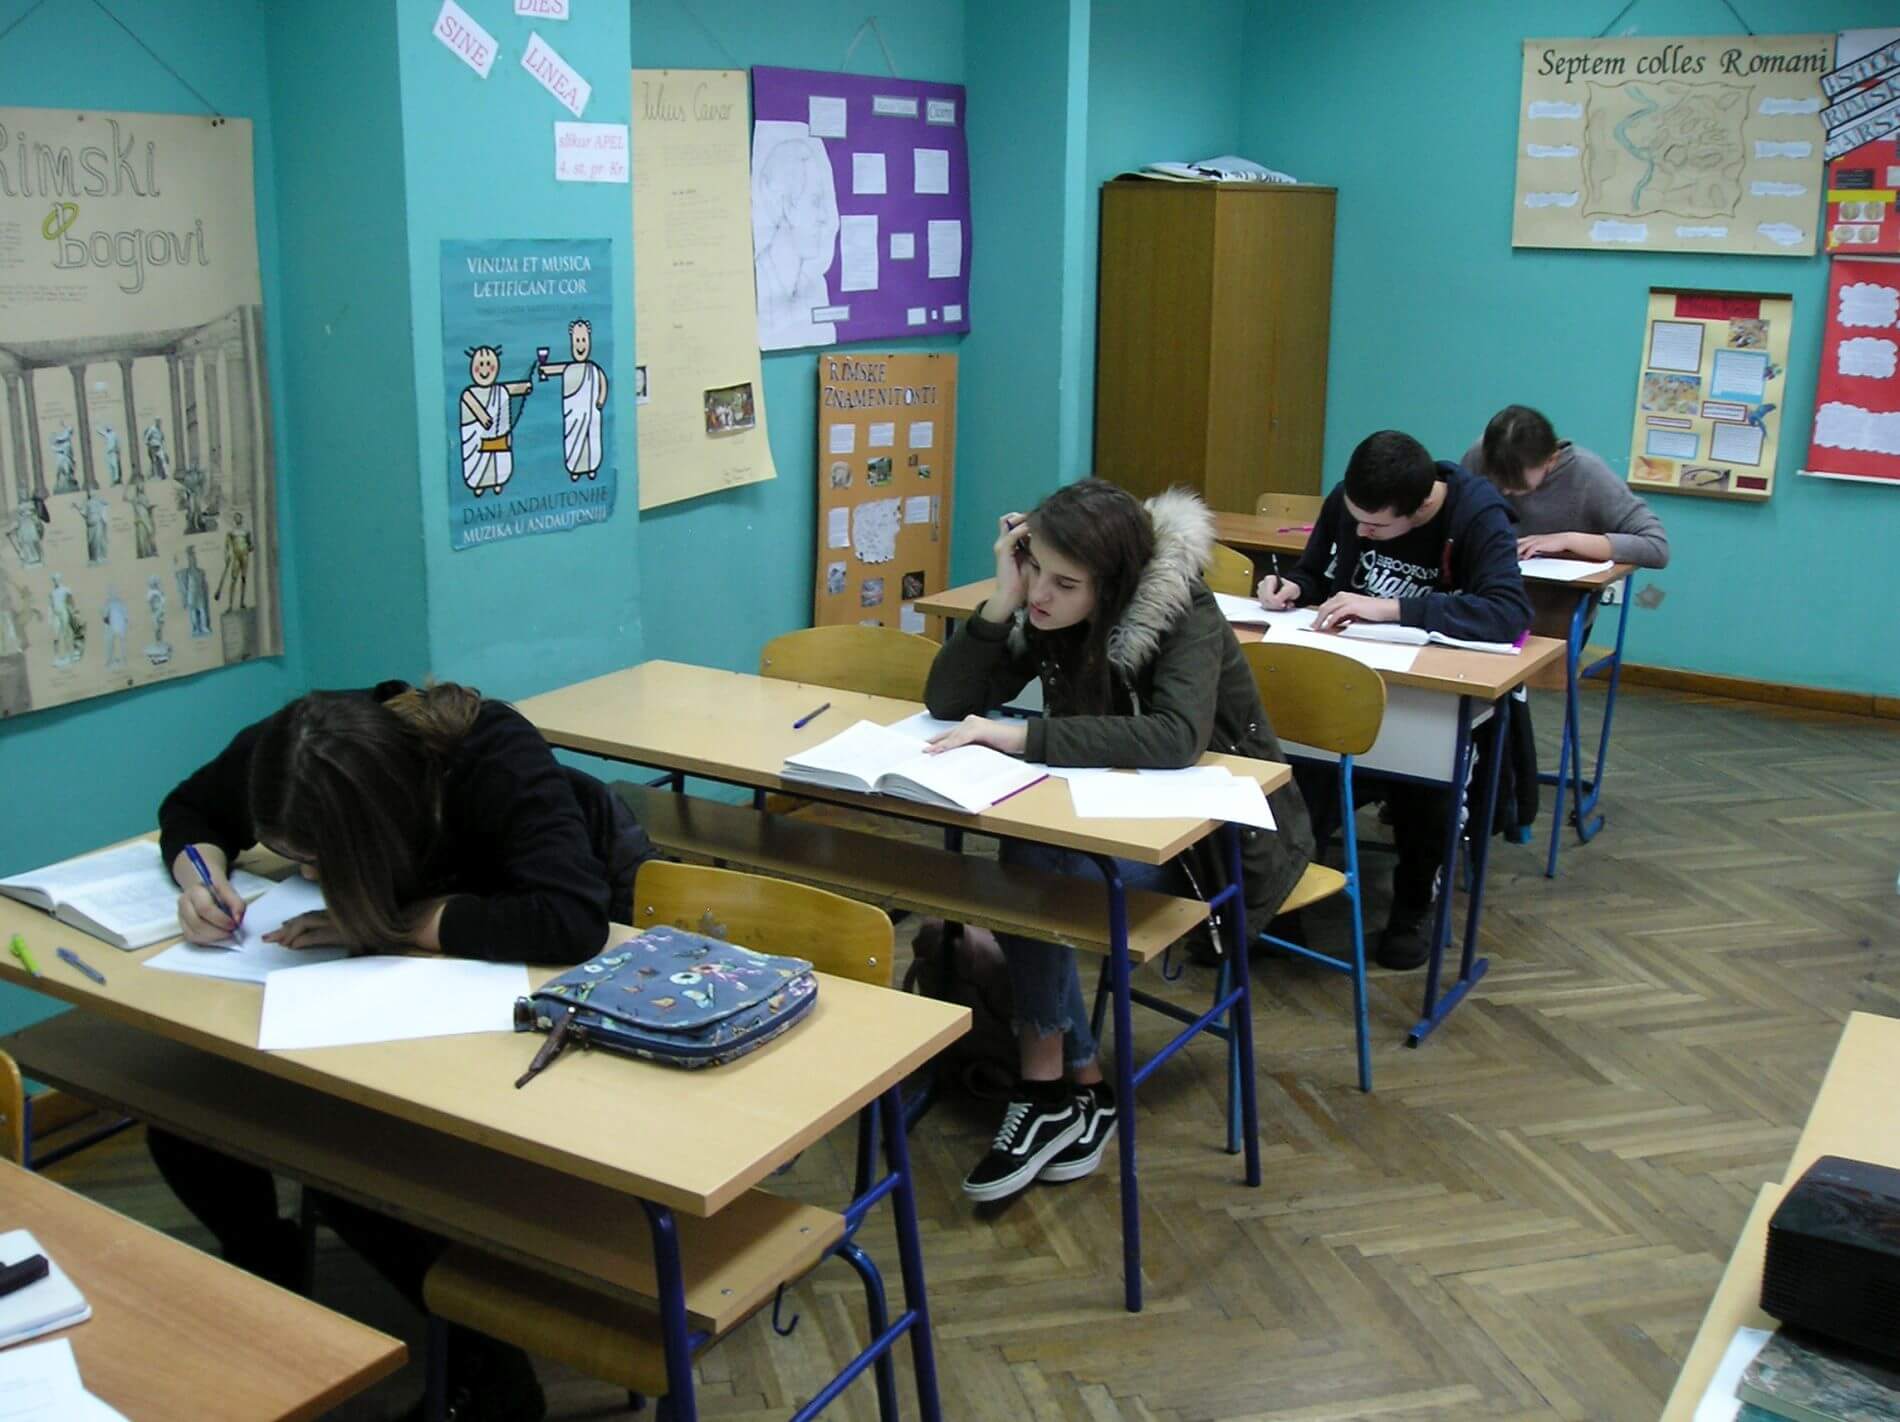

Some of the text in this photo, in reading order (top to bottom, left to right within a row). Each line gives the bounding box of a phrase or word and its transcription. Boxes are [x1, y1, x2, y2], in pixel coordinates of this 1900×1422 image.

[439, 15, 489, 67] SINE
[1538, 45, 1828, 84] Septem colles Romani
[467, 255, 592, 273] VINUM ET MUSICA
[558, 278, 588, 295] COR
[463, 503, 502, 525] DANI
[463, 522, 513, 545] MUZIKA
[514, 518, 525, 535] U
